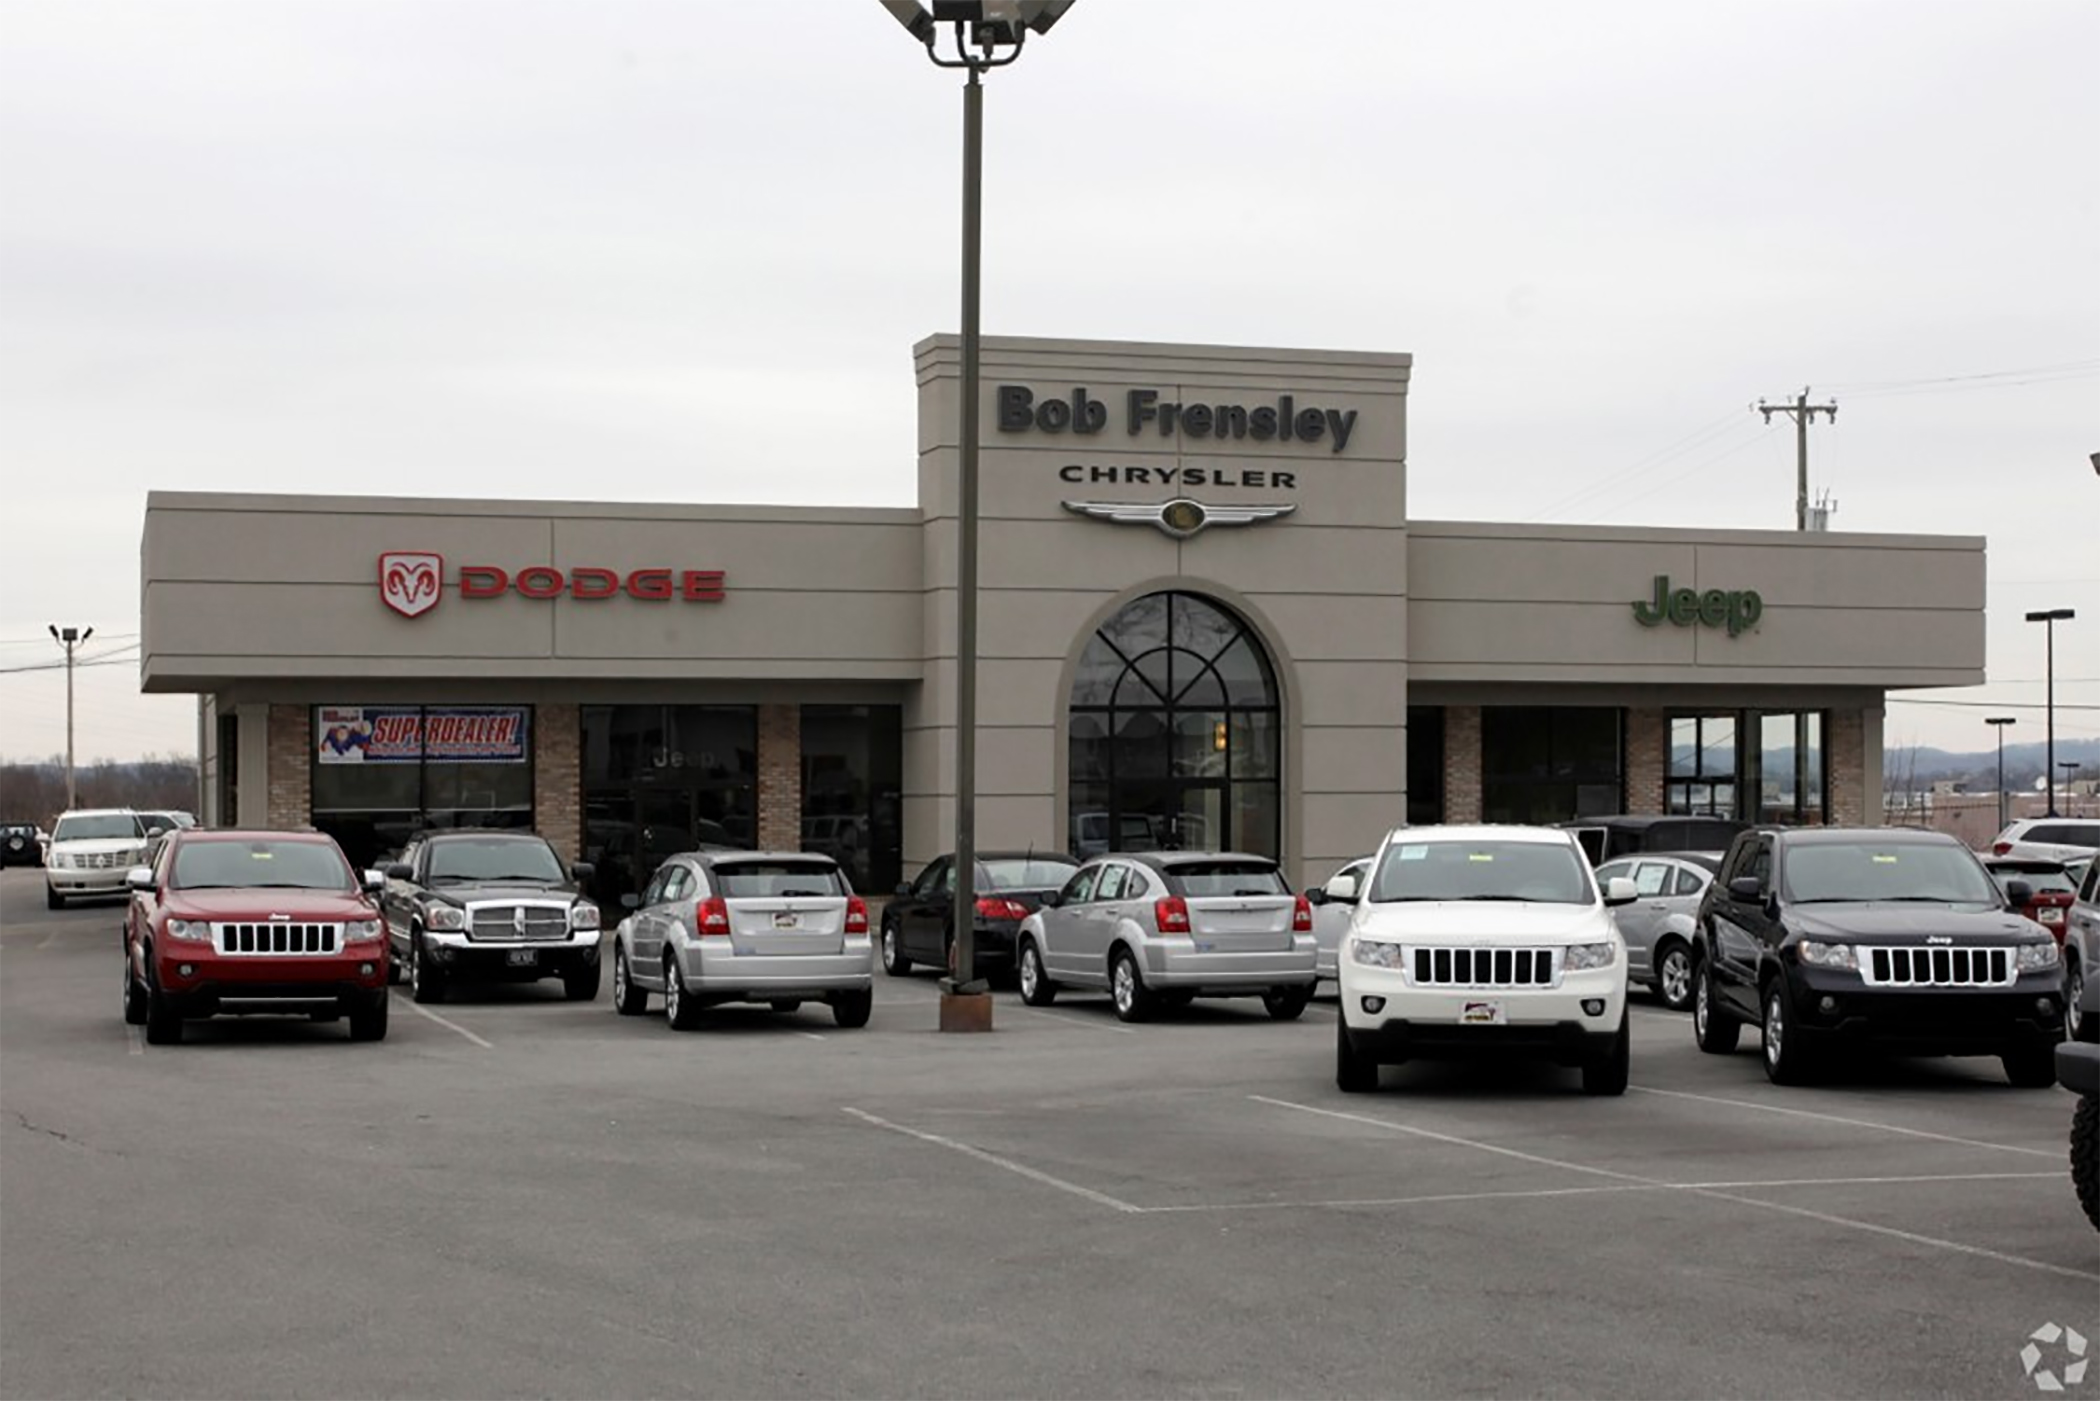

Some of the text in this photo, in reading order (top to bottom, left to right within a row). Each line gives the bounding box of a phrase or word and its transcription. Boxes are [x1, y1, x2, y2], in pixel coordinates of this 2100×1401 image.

[997, 385, 1358, 453] Bob Frensley
[1058, 465, 1296, 488] CHRYSLER
[459, 566, 727, 602] DODGE
[1631, 574, 1763, 639] Jeep
